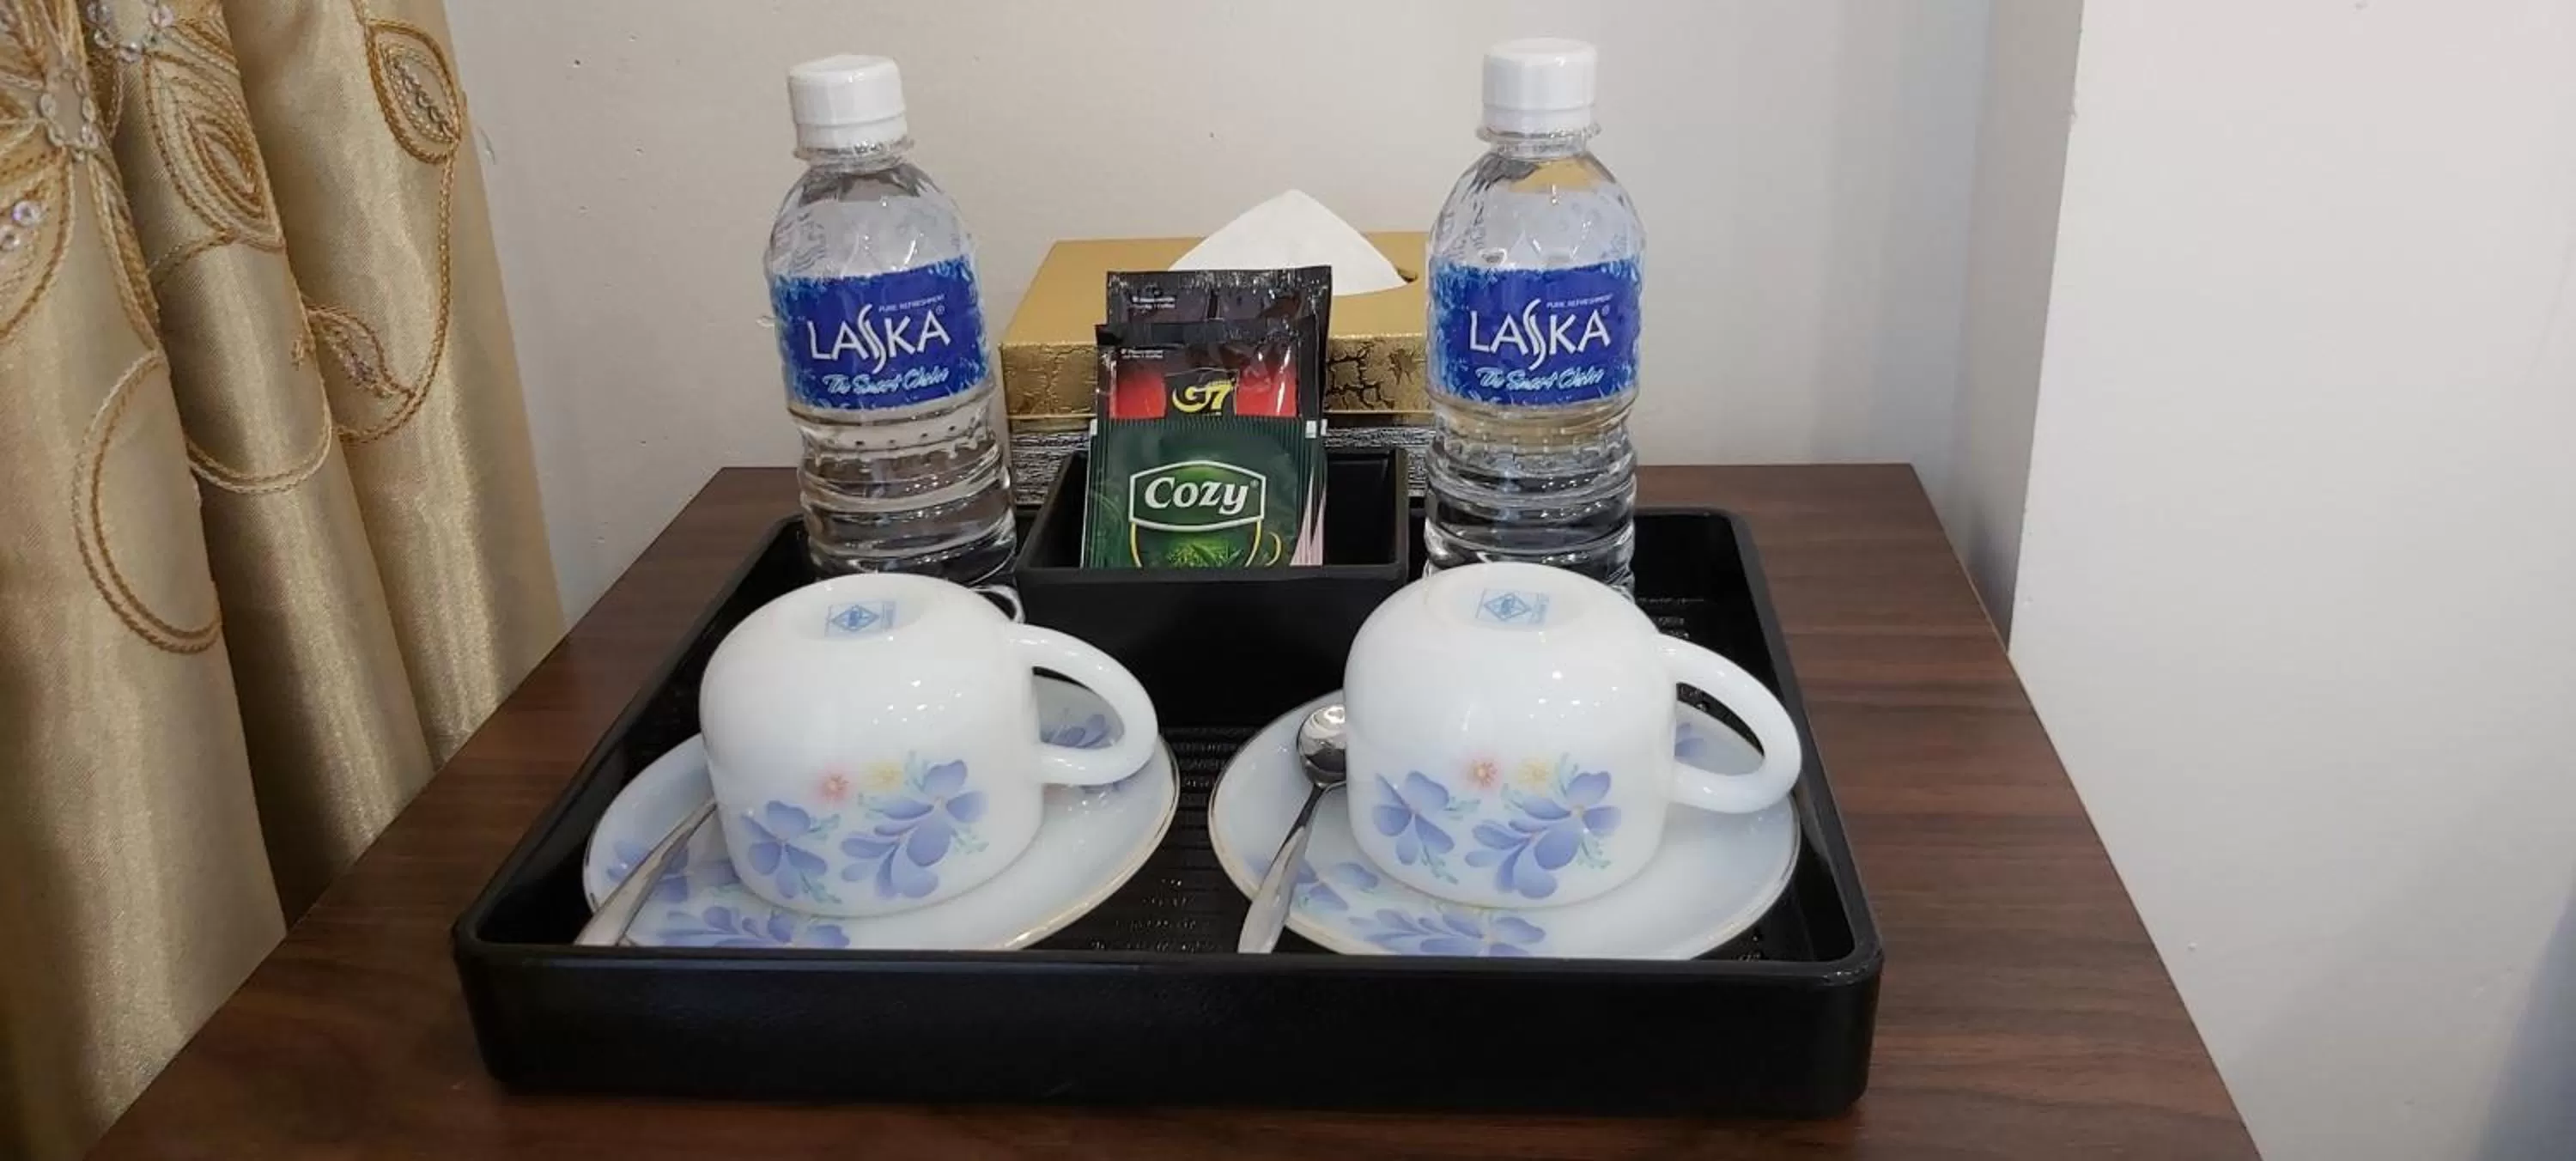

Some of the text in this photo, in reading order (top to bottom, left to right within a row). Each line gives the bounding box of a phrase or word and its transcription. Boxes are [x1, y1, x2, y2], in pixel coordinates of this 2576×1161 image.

[807, 303, 951, 374] LASKA
[1469, 298, 1611, 371] LASKA
[1172, 379, 1232, 413] G7
[1144, 476, 1249, 515] Cozy
